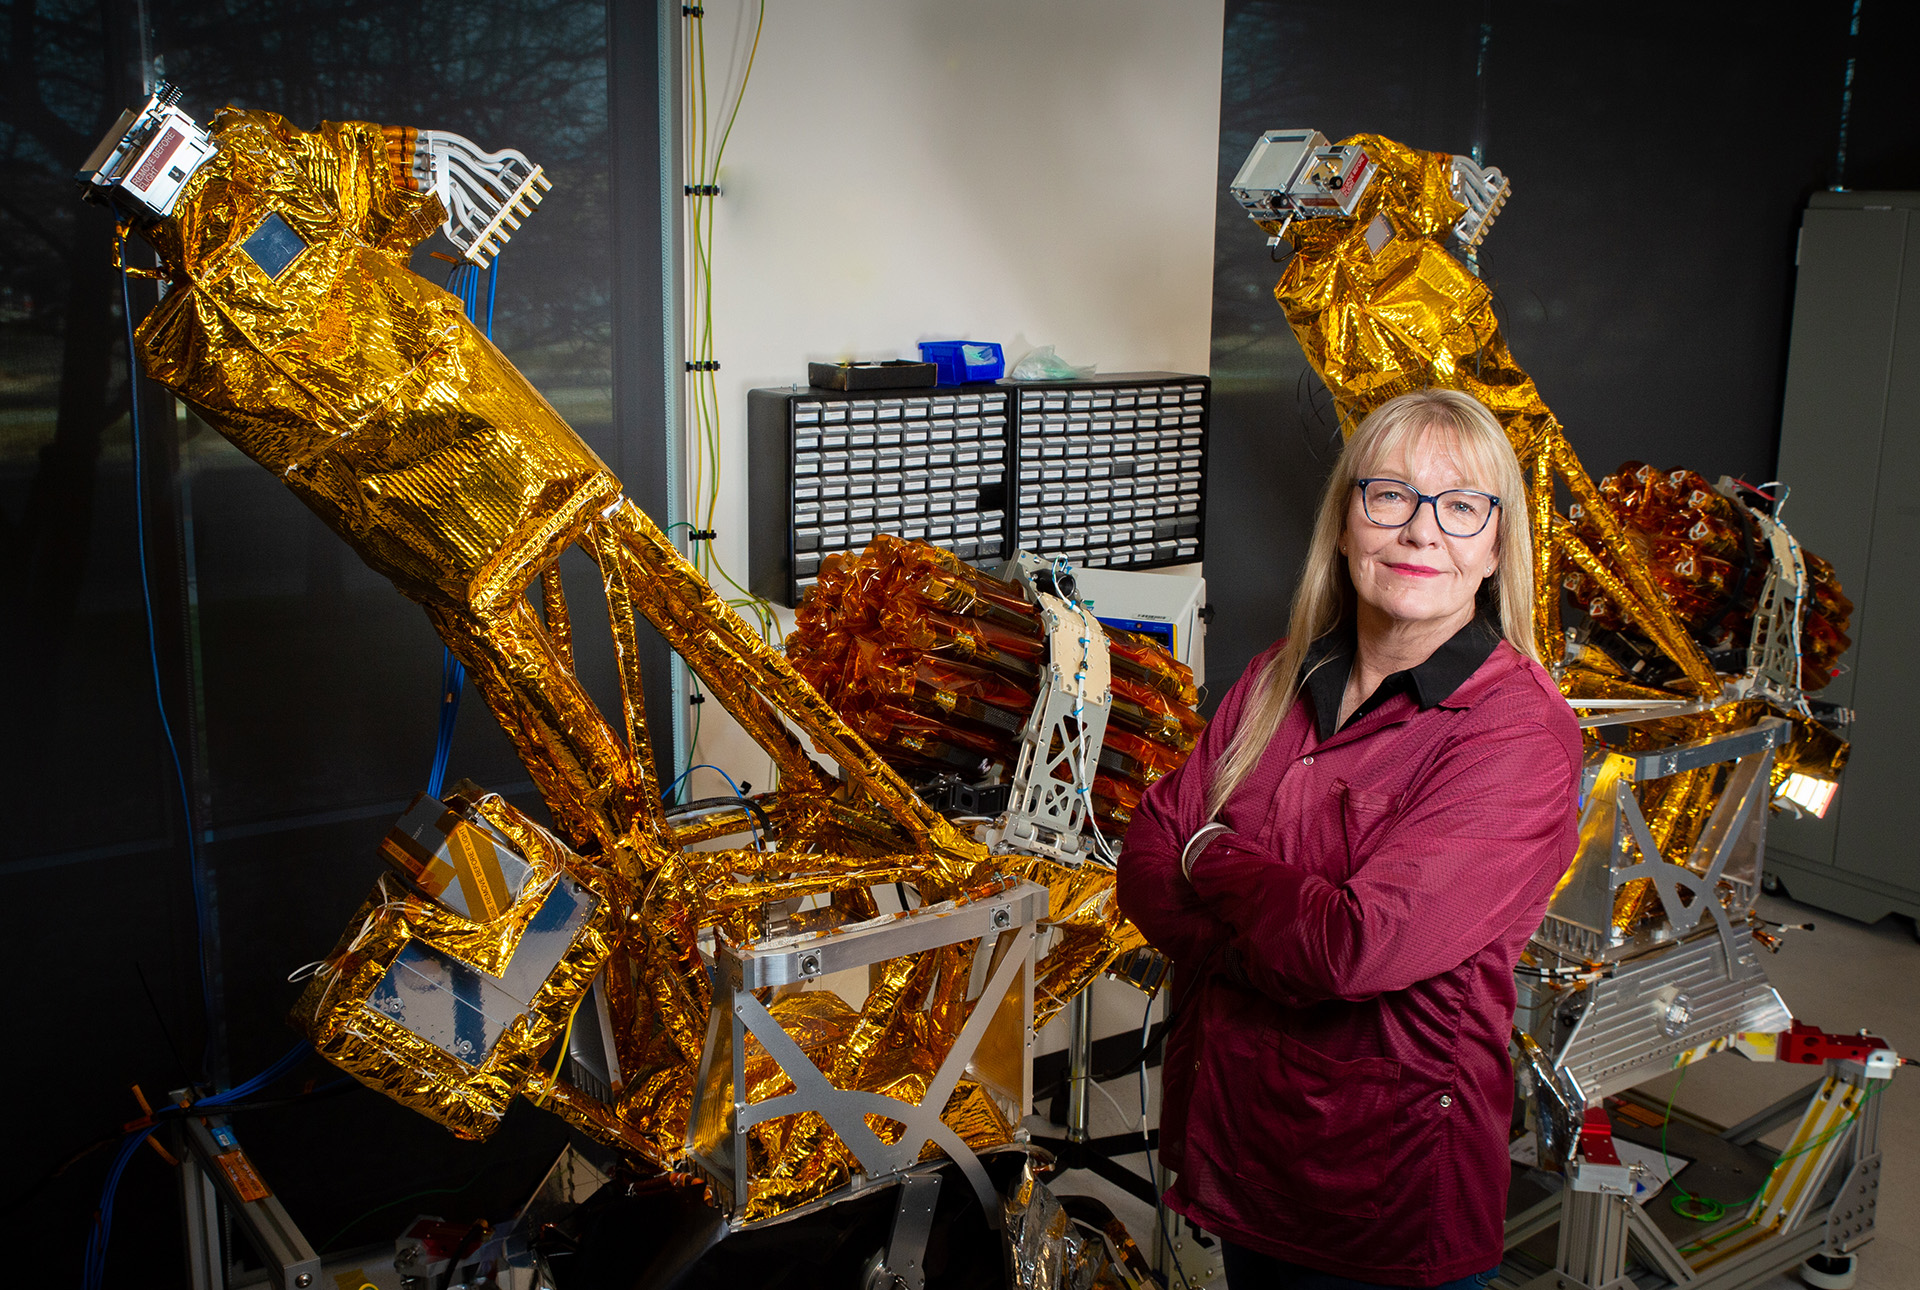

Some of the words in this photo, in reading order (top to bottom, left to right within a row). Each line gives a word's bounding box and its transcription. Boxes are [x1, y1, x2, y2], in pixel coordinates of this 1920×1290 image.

[132, 155, 158, 186] REMOVE
[153, 131, 176, 159] BEFORE
[139, 167, 159, 190] FLIGHT
[458, 827, 471, 851] FLIGHT
[468, 851, 482, 878] BEFORE
[478, 877, 492, 905] REMOVE
